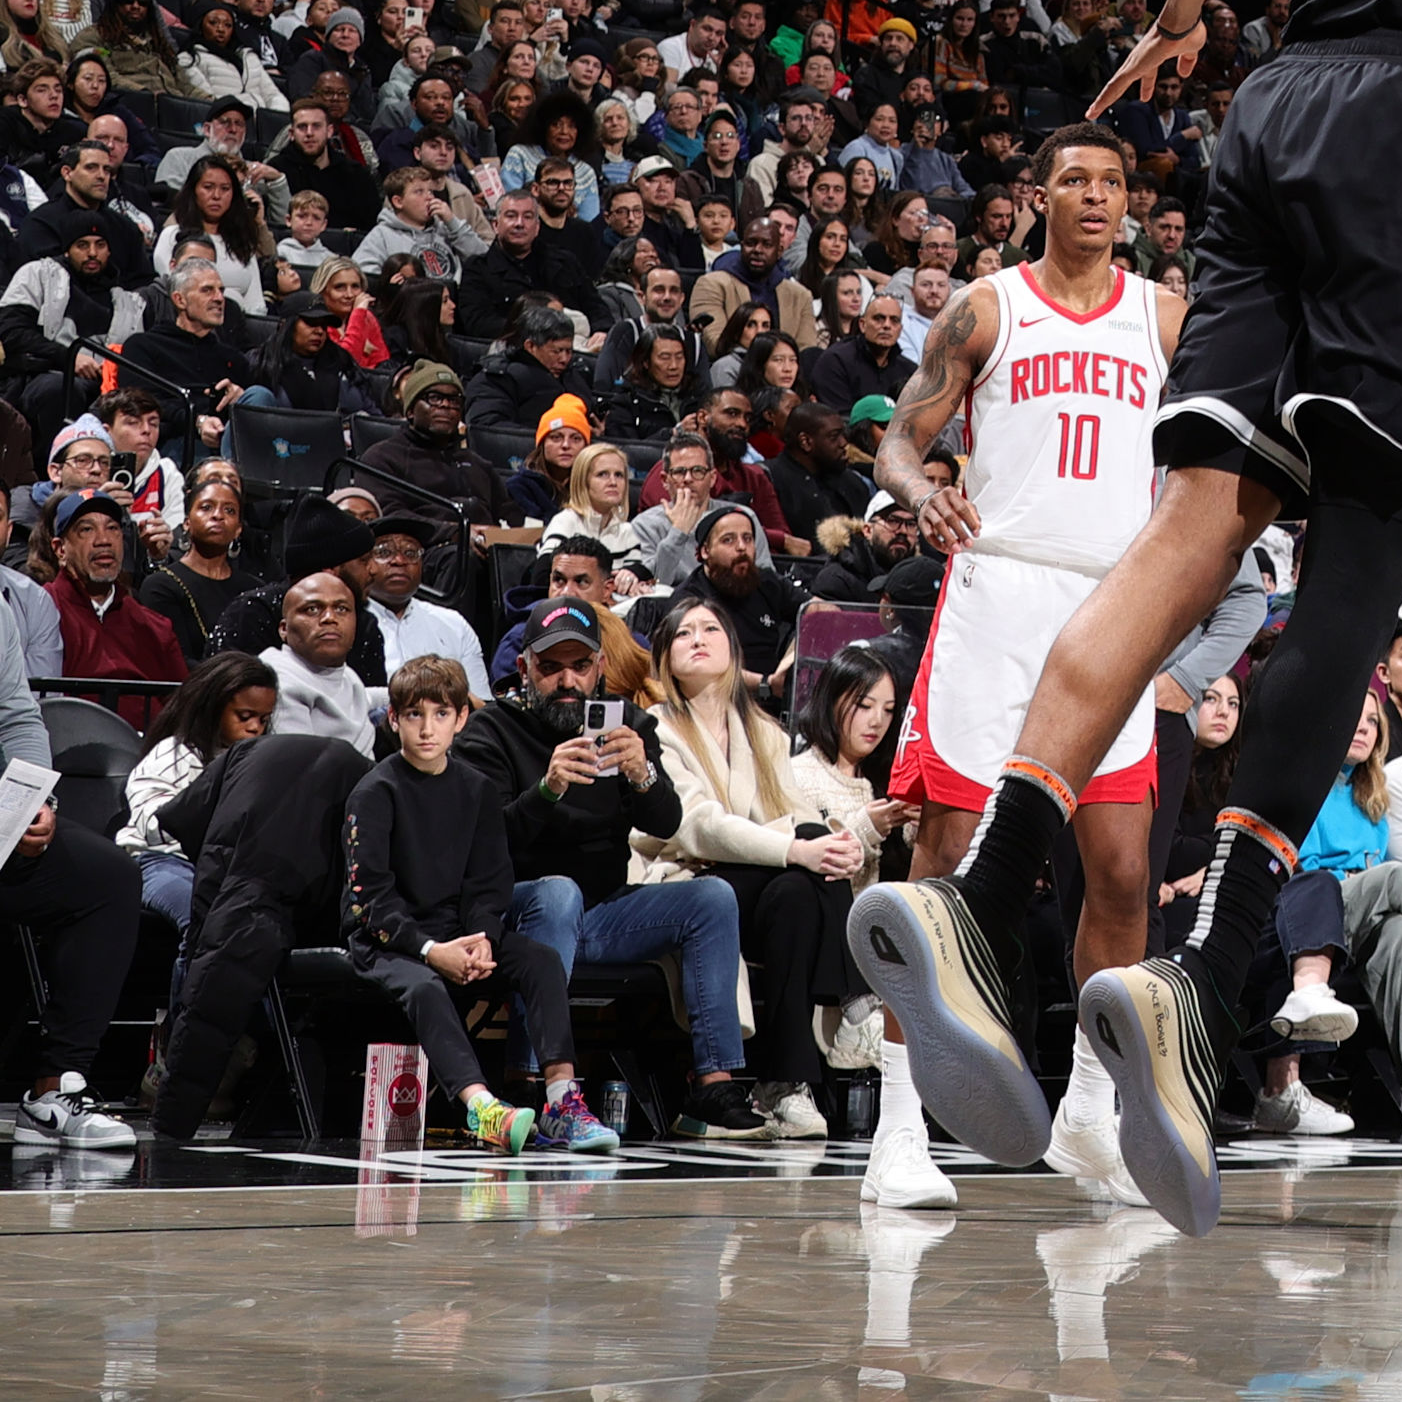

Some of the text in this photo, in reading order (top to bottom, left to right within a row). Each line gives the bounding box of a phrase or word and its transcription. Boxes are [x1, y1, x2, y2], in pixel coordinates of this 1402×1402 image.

[1011, 350, 1148, 410] ROCKETS
[1057, 412, 1101, 481] 10
[366, 1055, 379, 1131] POPCORN
